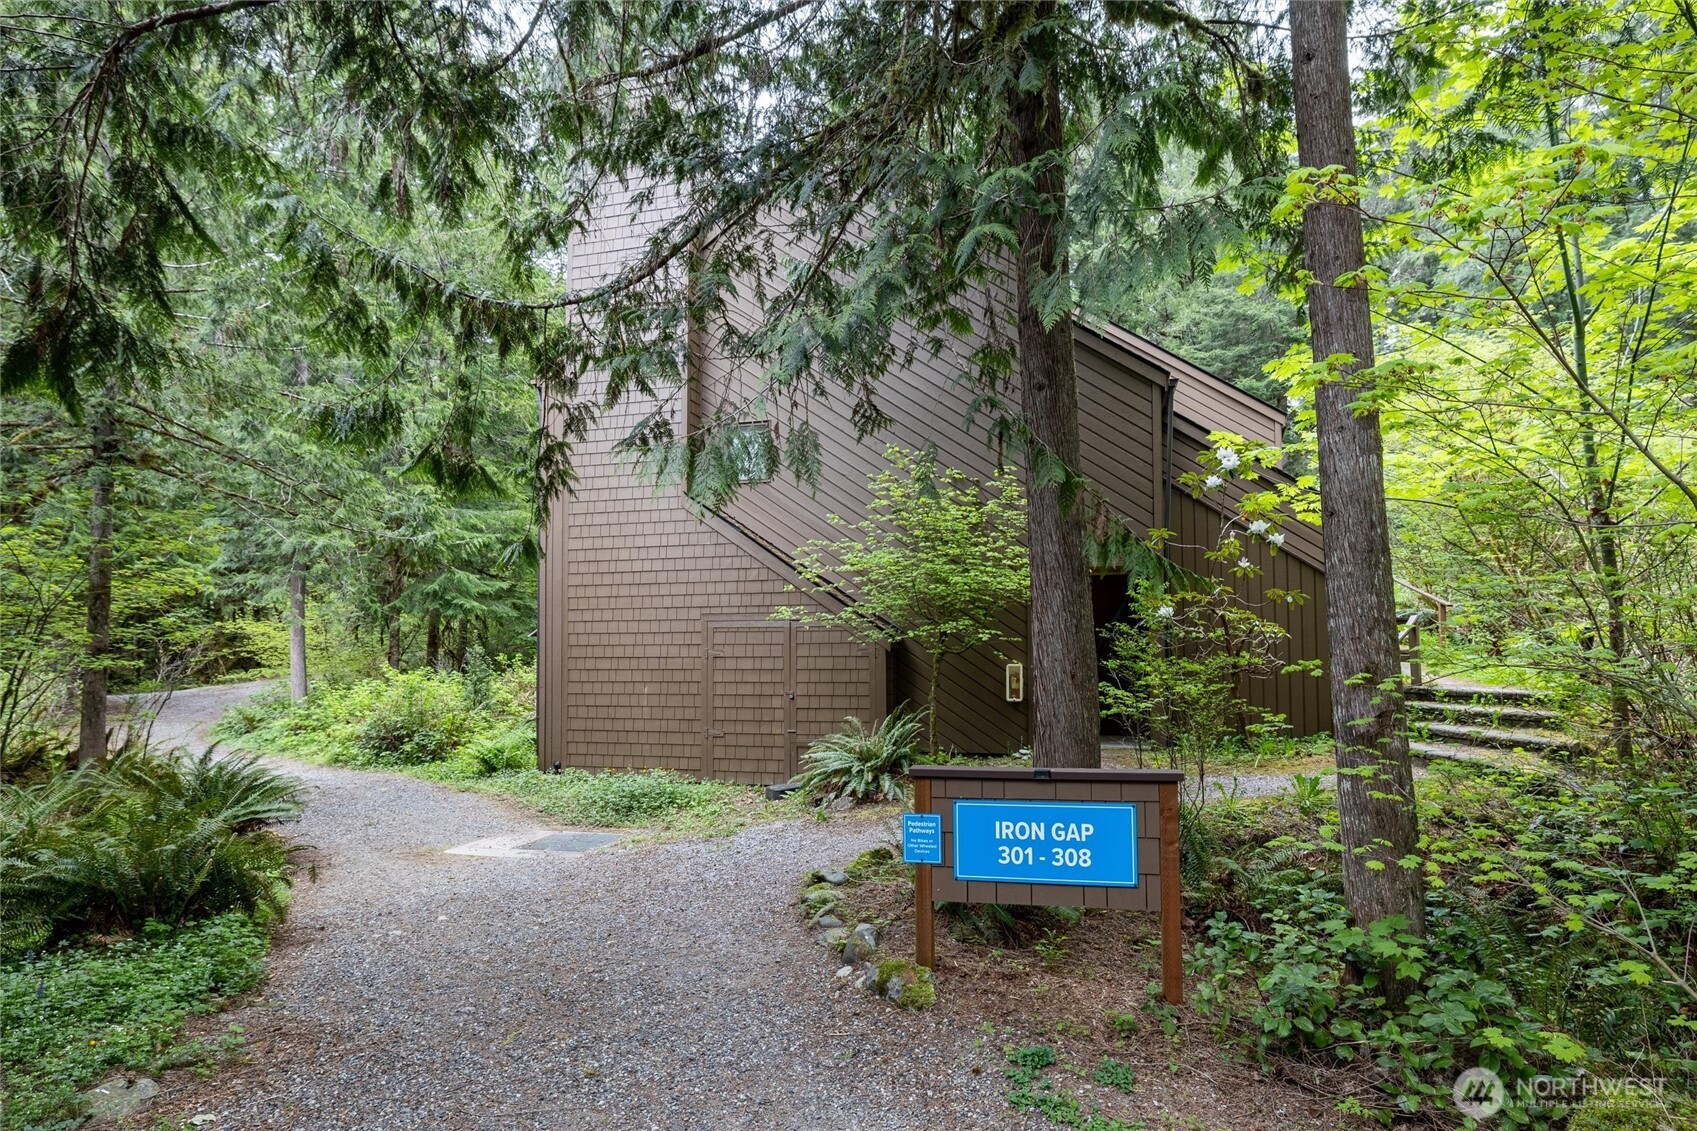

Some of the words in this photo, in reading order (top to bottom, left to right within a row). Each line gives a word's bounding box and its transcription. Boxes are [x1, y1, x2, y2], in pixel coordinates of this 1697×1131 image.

[909, 827, 935, 835] Pathways
[995, 821, 1045, 840] IRON
[1051, 822, 1094, 841] GAP
[998, 846, 1033, 865] 301
[1051, 847, 1092, 867] 308
